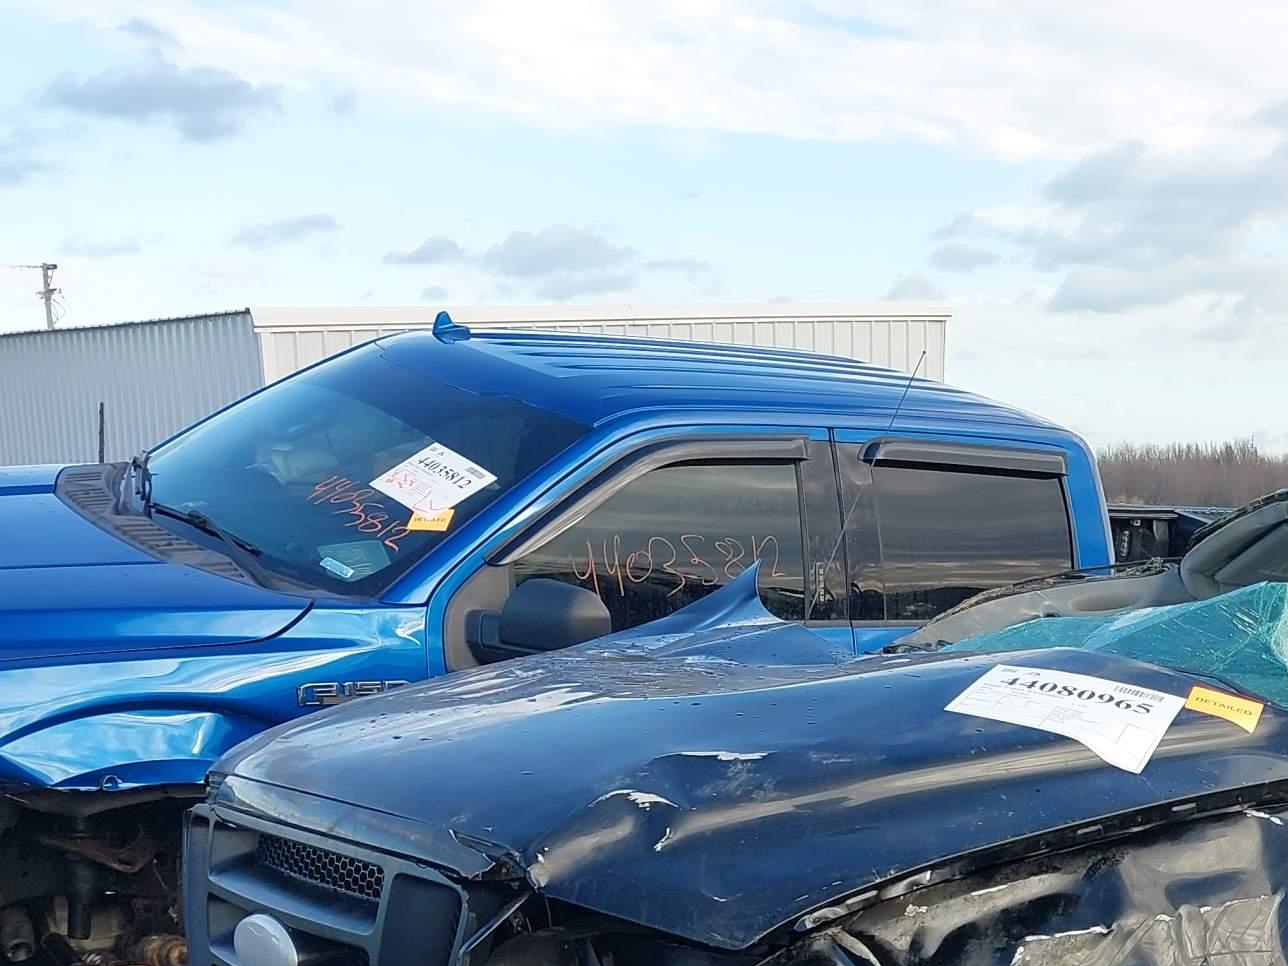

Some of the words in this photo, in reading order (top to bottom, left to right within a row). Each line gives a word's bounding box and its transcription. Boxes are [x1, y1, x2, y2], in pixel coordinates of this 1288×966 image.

[416, 456, 473, 489] 44035812
[306, 475, 411, 553] 44035812
[1000, 676, 1155, 716] 44080965
[1195, 695, 1253, 716] DETAILED
